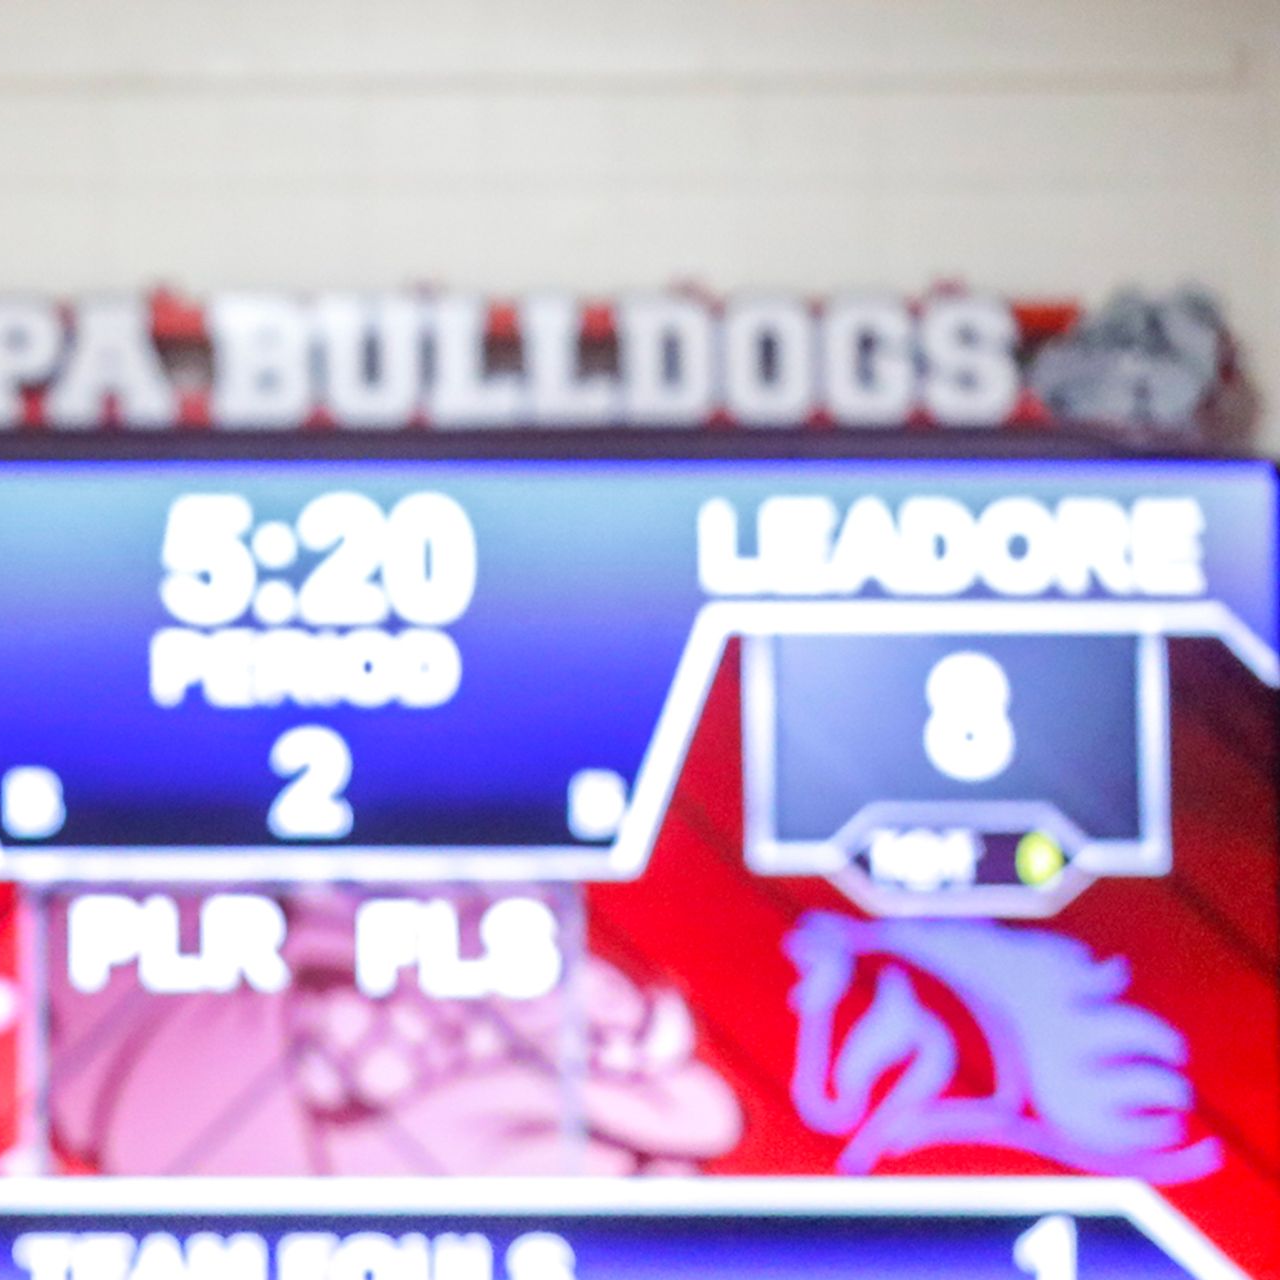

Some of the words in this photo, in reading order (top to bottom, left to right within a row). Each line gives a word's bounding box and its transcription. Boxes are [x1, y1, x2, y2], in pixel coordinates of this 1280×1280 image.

[212, 295, 1020, 430] BULLDOGS
[160, 491, 476, 626] 5:20
[698, 495, 1206, 596] LEADORE
[150, 627, 461, 708] PERIOD
[924, 651, 1015, 781] 8
[268, 725, 354, 839] 2
[68, 894, 290, 992] PLR
[356, 897, 561, 999] FLS
